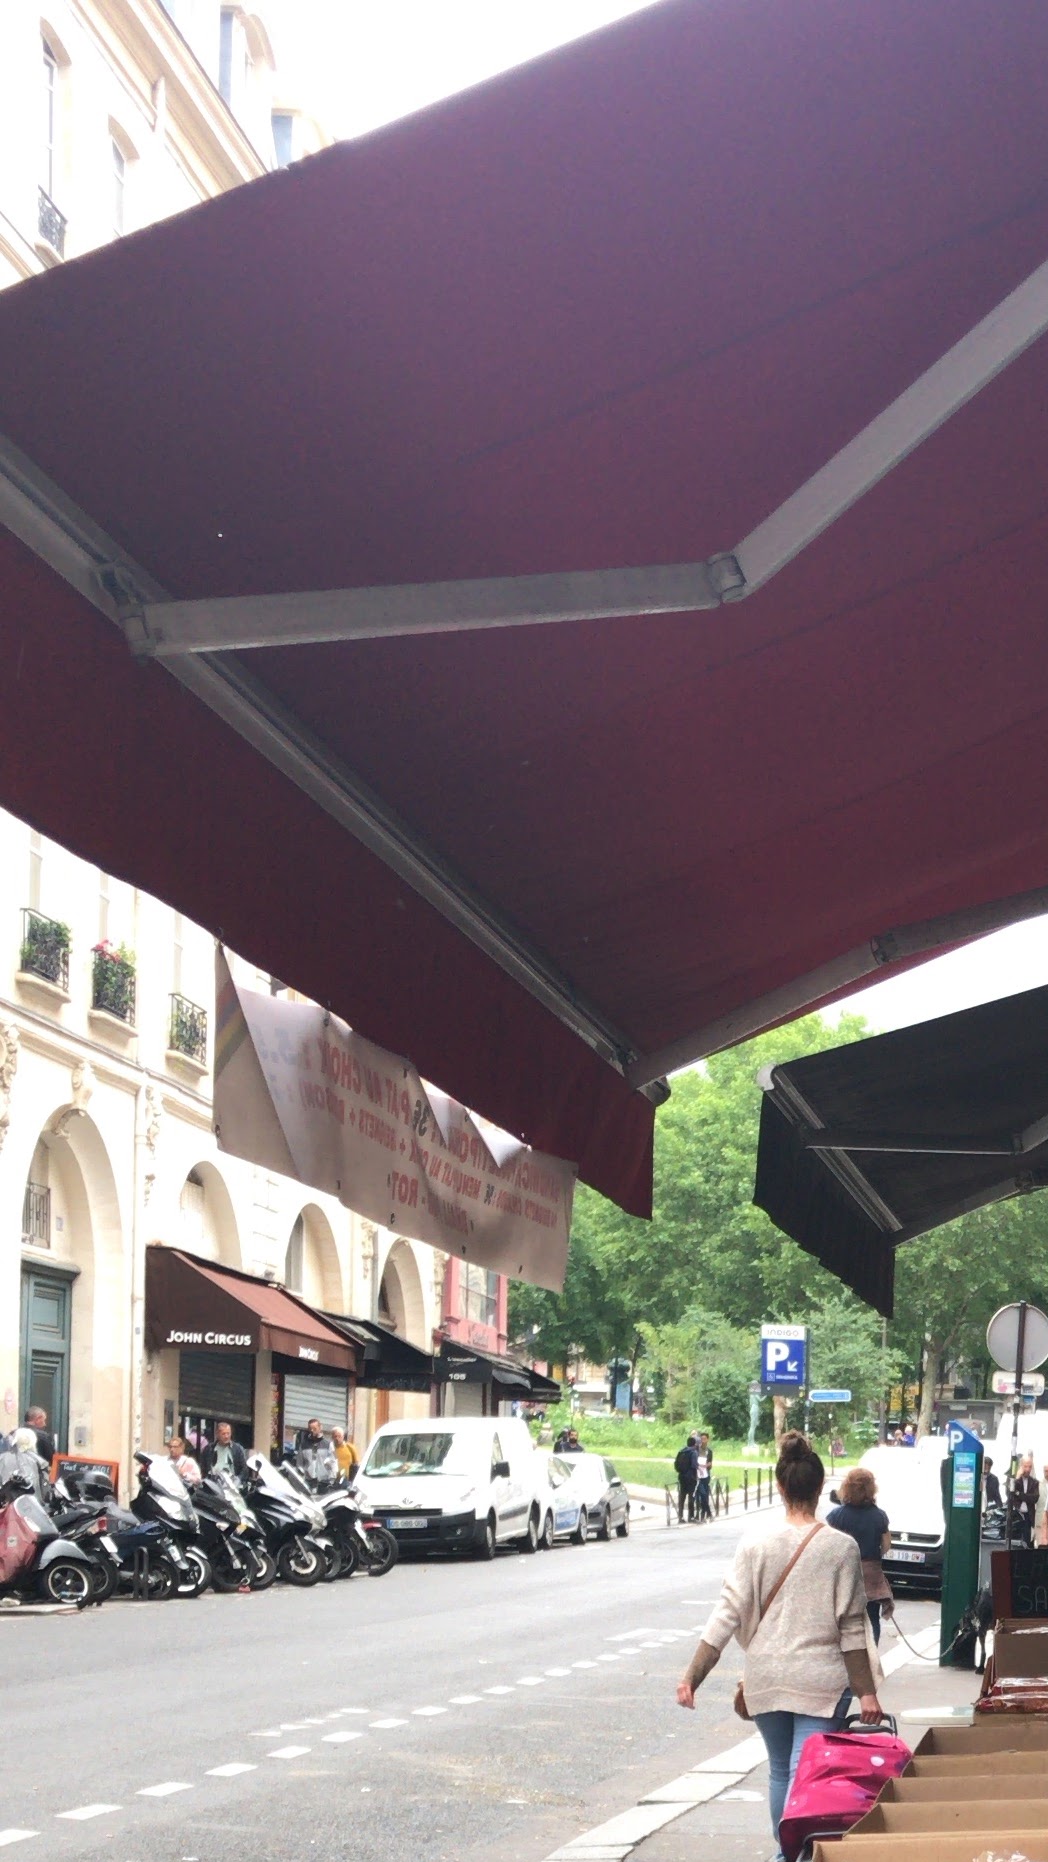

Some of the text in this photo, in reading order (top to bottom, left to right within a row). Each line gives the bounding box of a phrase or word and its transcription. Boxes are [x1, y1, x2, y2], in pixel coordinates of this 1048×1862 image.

[166, 1330, 252, 1346] JOHN CIRCUS
[766, 1341, 790, 1371] P
[950, 1431, 964, 1451] P
